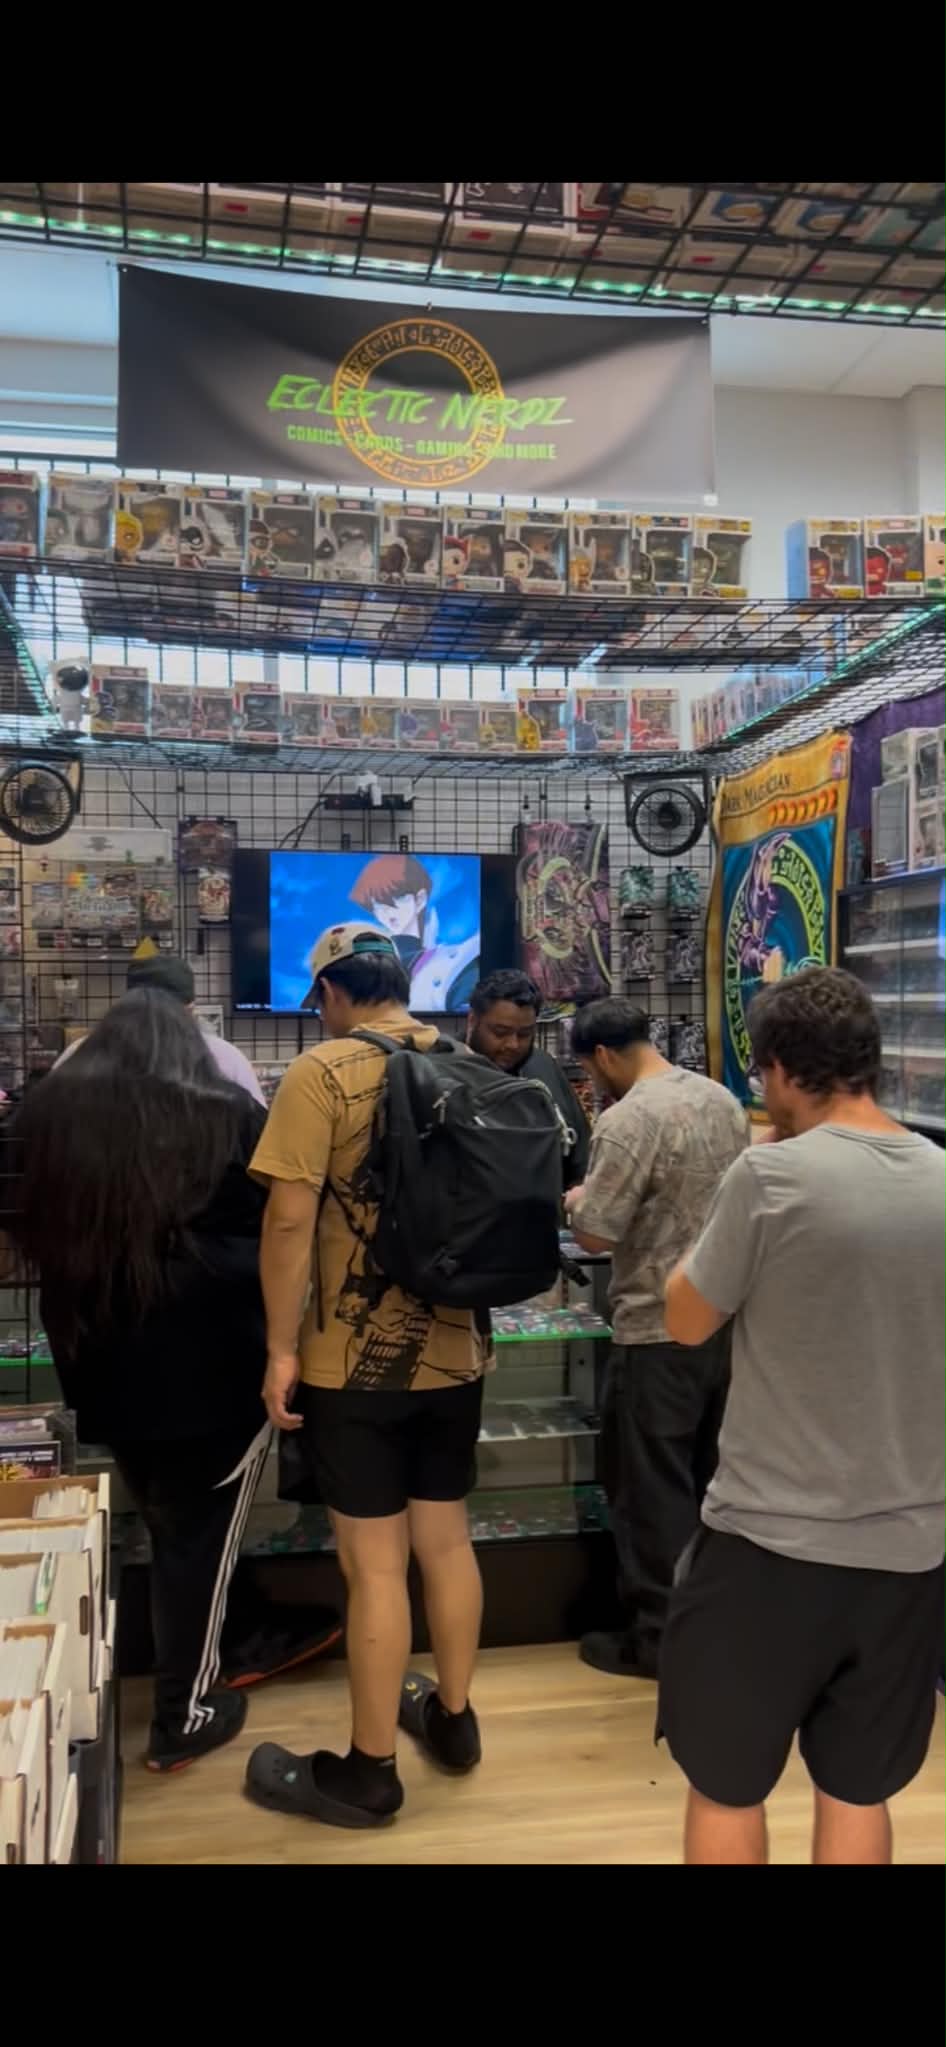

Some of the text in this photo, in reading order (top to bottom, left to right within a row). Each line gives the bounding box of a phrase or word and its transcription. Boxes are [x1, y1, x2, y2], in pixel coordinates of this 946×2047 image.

[266, 374, 574, 431] ECLECTIC NERDZ
[287, 424, 343, 447] COMICS
[354, 431, 403, 453] CARDS
[514, 443, 557, 462] MORE
